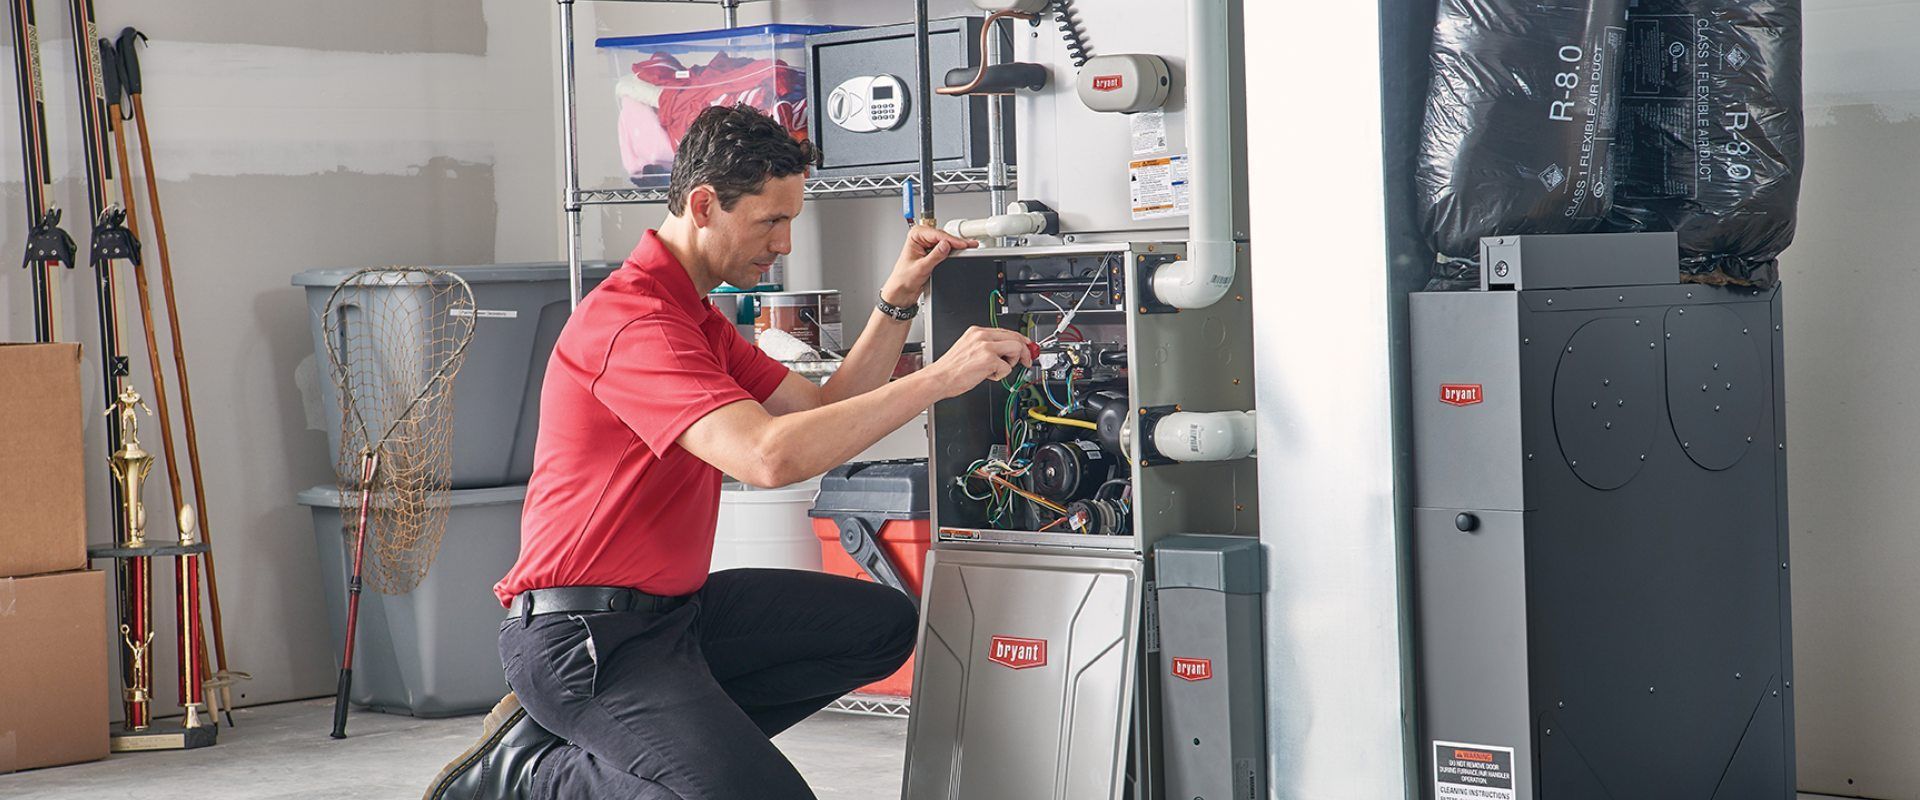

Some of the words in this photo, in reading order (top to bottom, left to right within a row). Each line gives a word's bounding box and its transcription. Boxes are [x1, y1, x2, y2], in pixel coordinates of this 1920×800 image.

[1697, 18, 1710, 58] CLASS
[1592, 44, 1604, 82] DUCT
[1549, 44, 1583, 122] R-8.0
[1588, 84, 1600, 106] AIR
[1697, 71, 1710, 127] FLEXIBLE
[1580, 108, 1597, 167] FLEXIBLE
[1698, 129, 1710, 148] AIR
[1724, 112, 1752, 180] R-8.0
[1699, 150, 1712, 183] DUCT
[1564, 180, 1586, 217] CLASS
[1445, 388, 1476, 402] bryant
[996, 641, 1039, 662] bryant
[1176, 660, 1206, 676] bryant
[1439, 766, 1457, 774] DURING
[1488, 771, 1510, 779] HANDLER
[1467, 761, 1485, 770] REMOVE
[1440, 786, 1467, 796] CLEANING
[1468, 788, 1511, 800] INSTRUCTIONS
